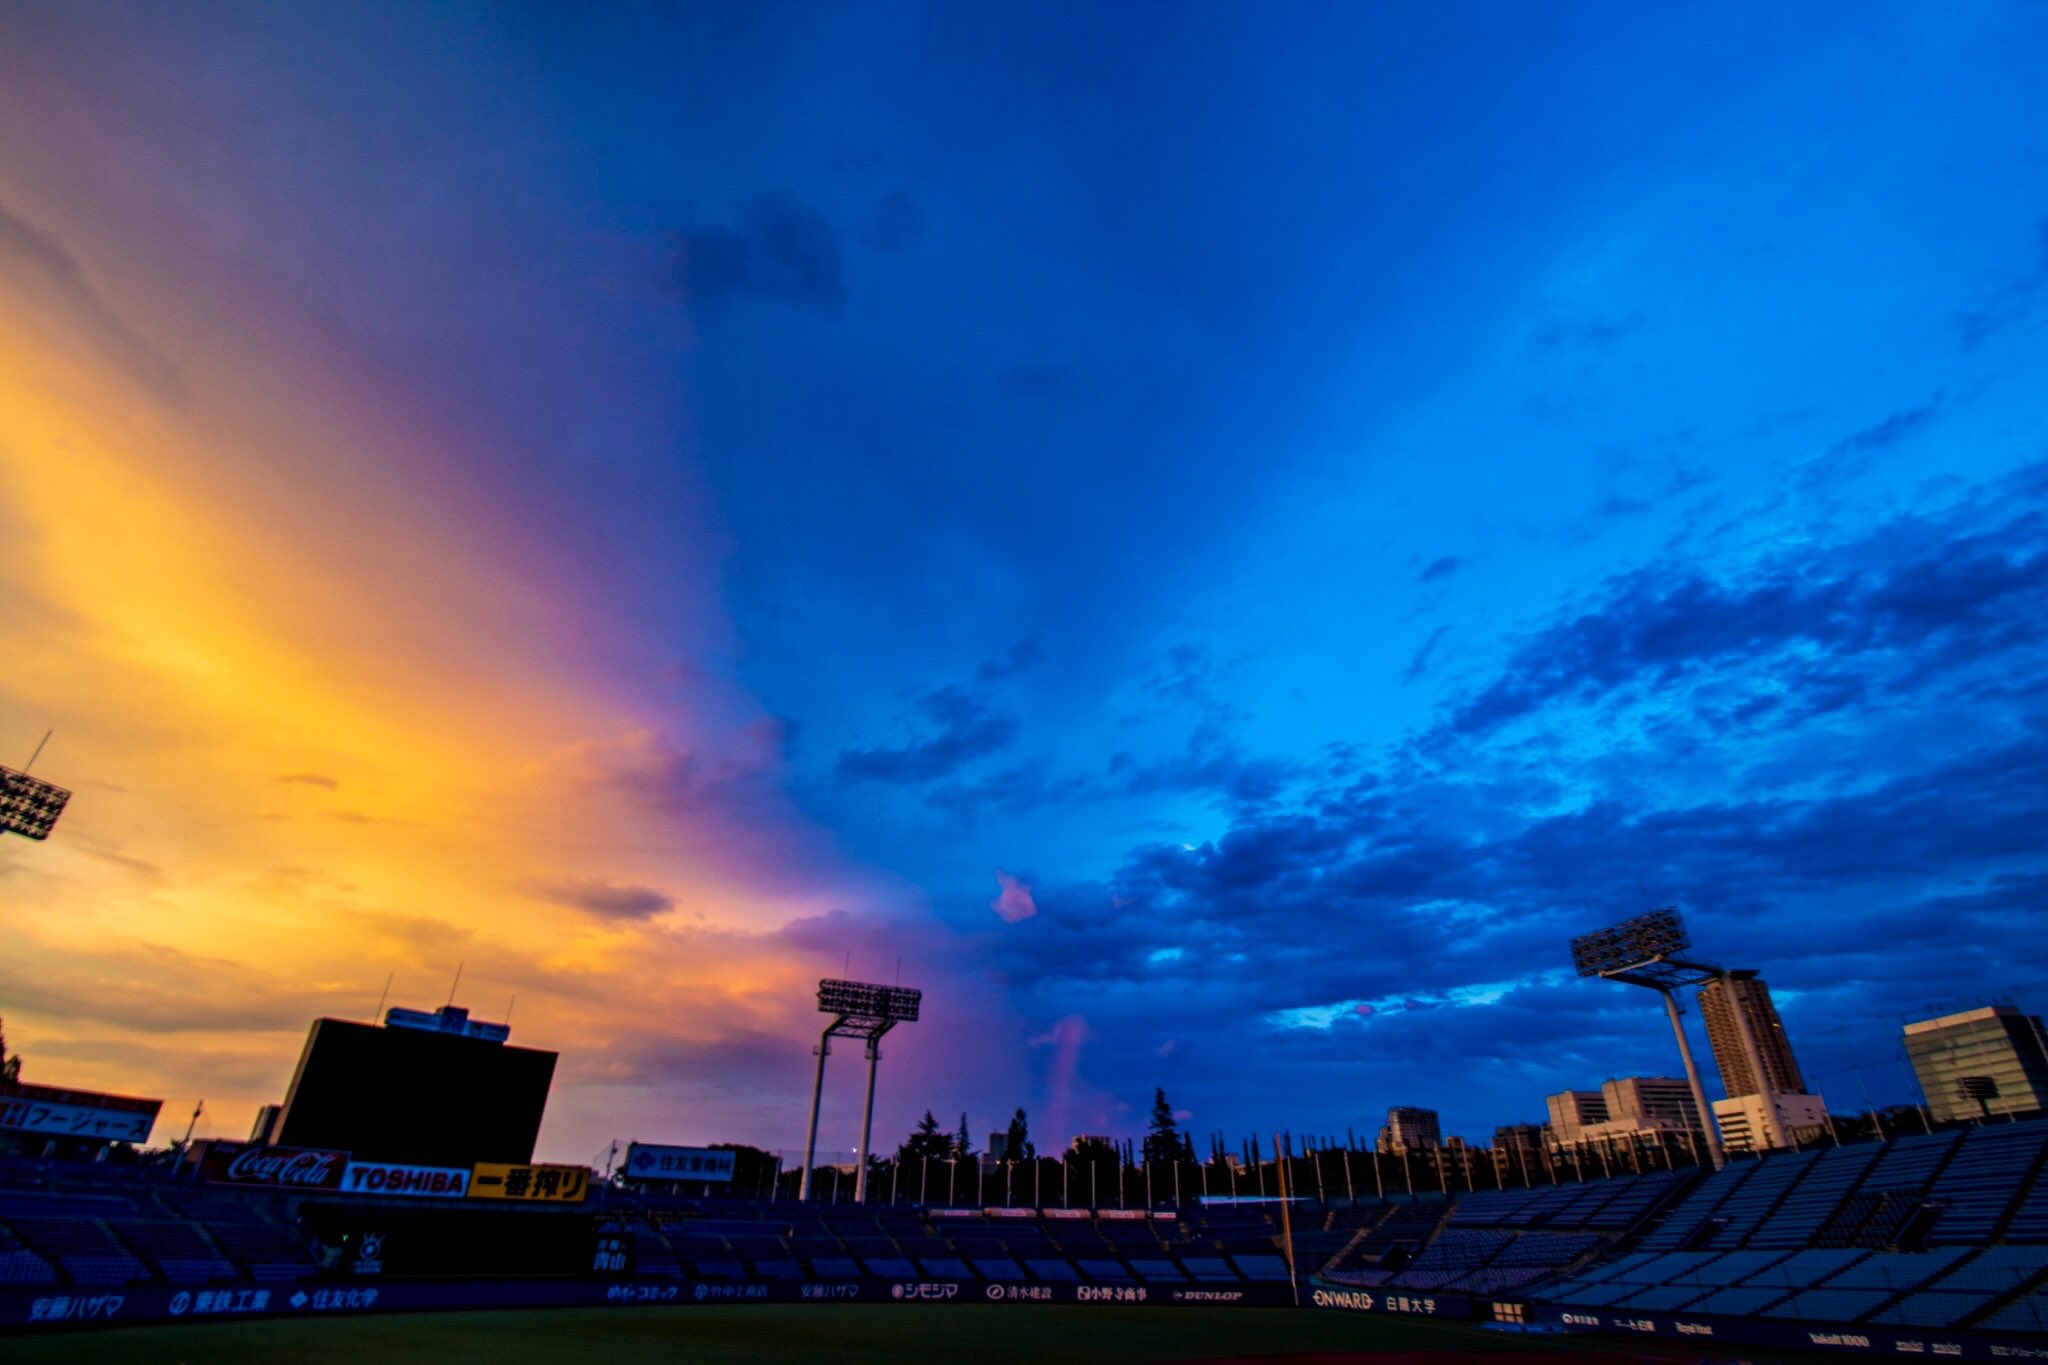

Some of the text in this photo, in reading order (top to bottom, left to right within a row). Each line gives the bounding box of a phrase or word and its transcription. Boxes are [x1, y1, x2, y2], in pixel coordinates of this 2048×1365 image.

[30, 1107, 148, 1136] フージャース
[351, 1166, 464, 1194] TOSHIBA
[476, 1167, 586, 1198] 一番搾り
[192, 1288, 273, 1314] 東鉄工業
[312, 1287, 381, 1311] 住友化学
[905, 1282, 959, 1299] シモジマ
[1006, 1285, 1052, 1301] 清水建設
[1184, 1291, 1243, 1301] DUNLOP
[1312, 1289, 1375, 1310] ONWARD
